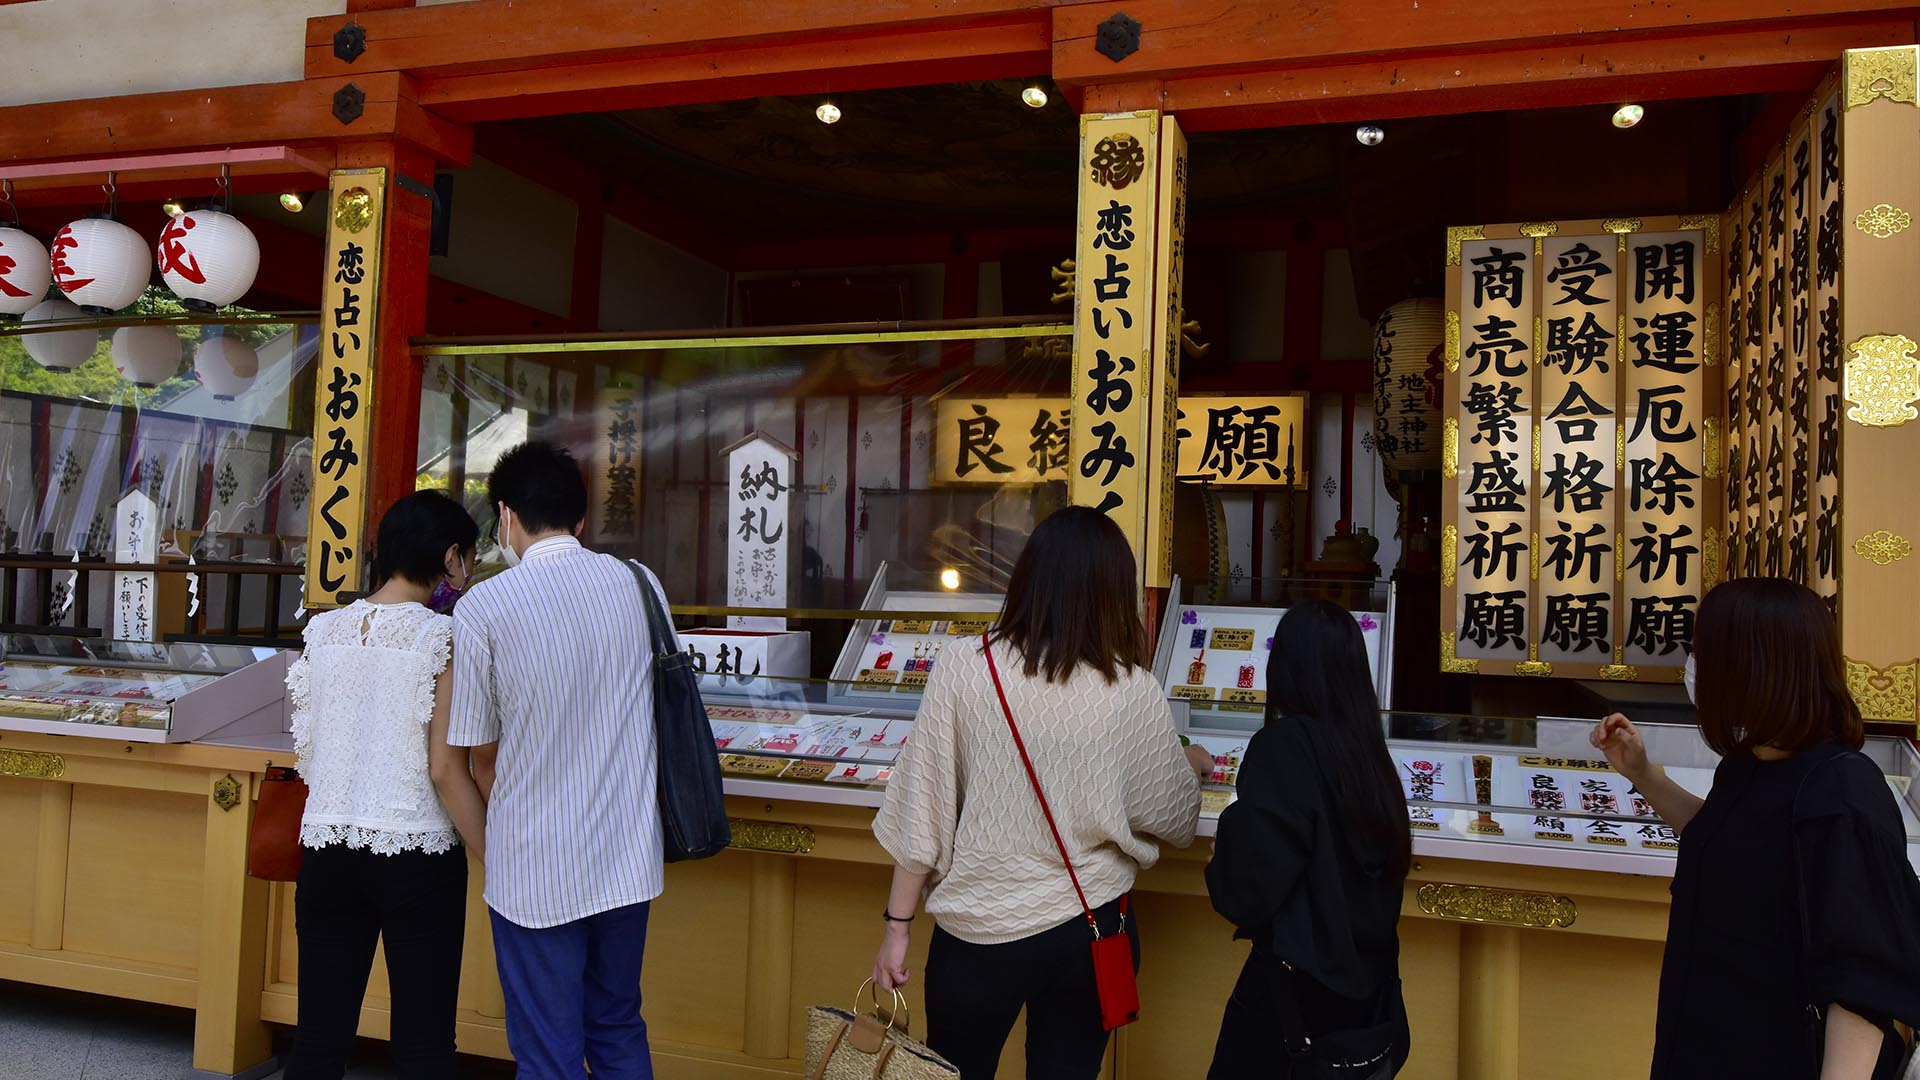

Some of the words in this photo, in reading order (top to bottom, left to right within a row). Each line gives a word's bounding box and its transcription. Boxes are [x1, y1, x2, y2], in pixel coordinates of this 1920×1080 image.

[1815, 108, 1838, 614] 良縁達成祈
[319, 242, 365, 592] 恋占いおみくじ
[955, 403, 1282, 481] 良縁願
[1397, 373, 1431, 455] 地主神社
[1459, 246, 1530, 651] 商売繁盛祈願
[1540, 242, 1616, 654] 受験合格祈願
[1625, 240, 1700, 656] 開運厄除祈願
[127, 510, 144, 564] お守り
[736, 460, 788, 544] 納札
[762, 547, 778, 597] 古いお札
[1523, 756, 1610, 770] ご祈願済
